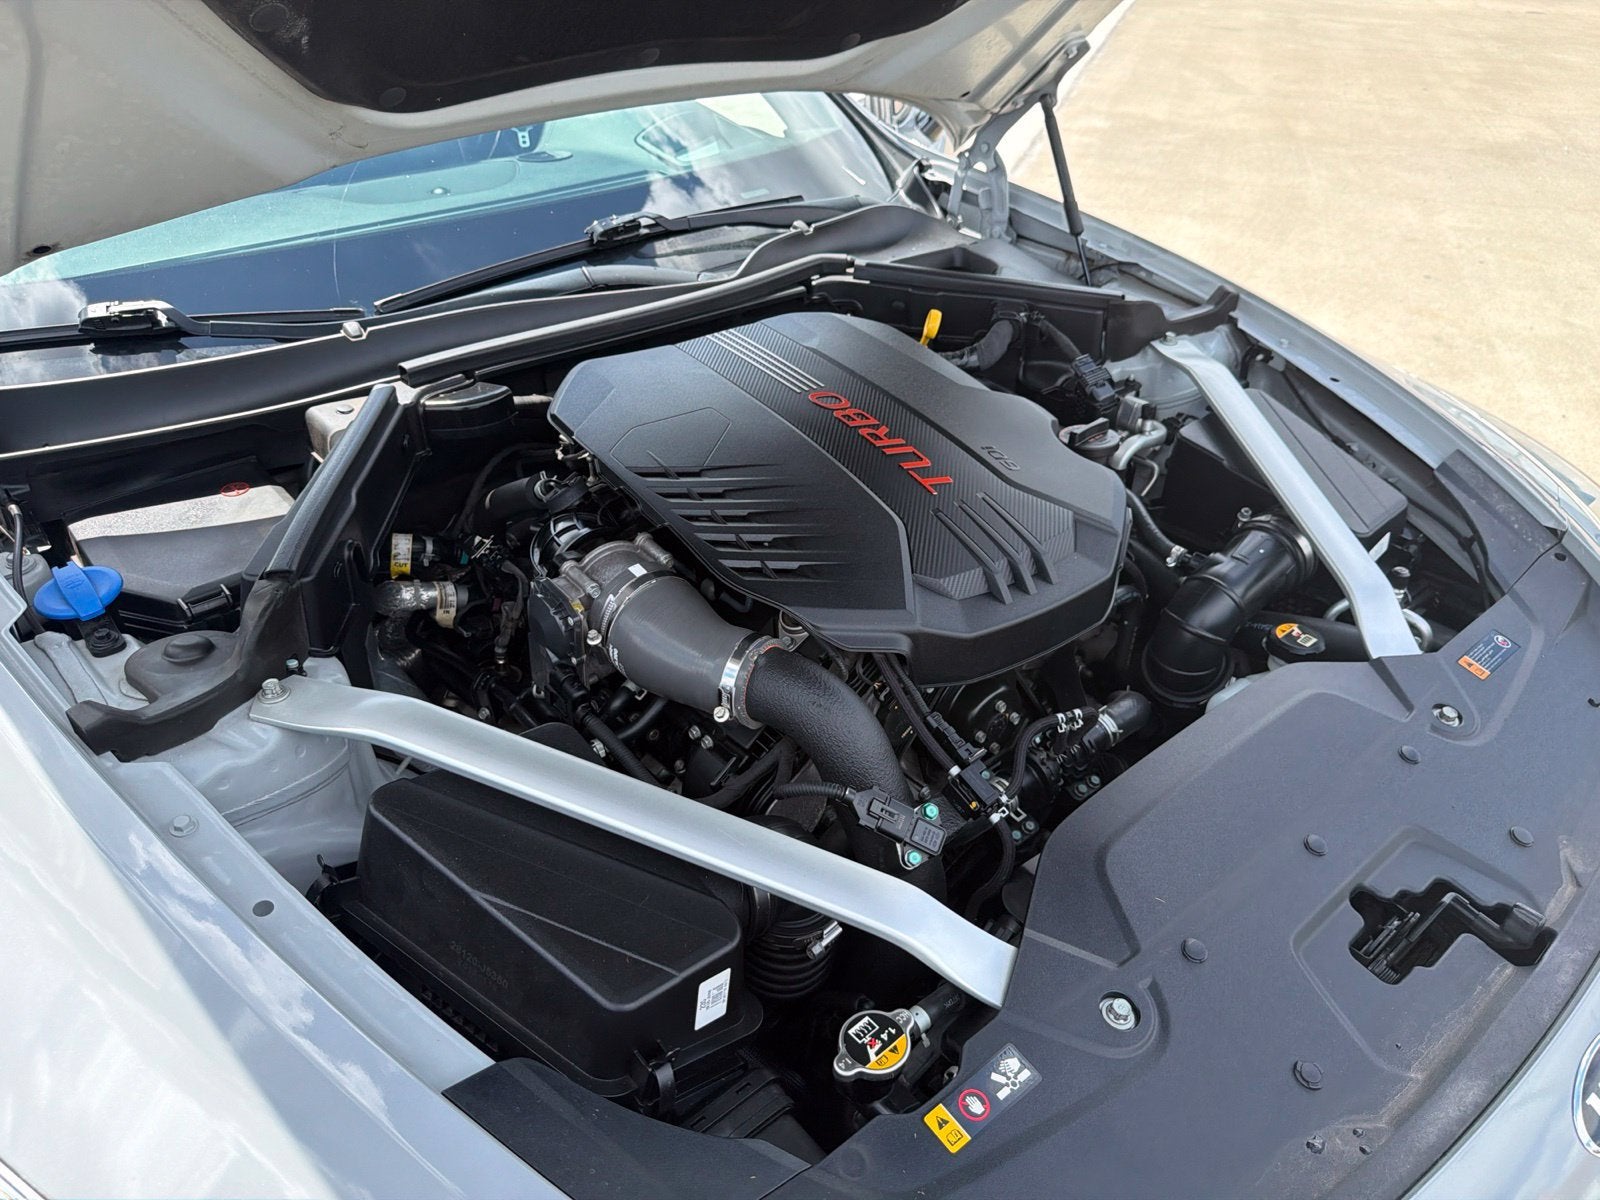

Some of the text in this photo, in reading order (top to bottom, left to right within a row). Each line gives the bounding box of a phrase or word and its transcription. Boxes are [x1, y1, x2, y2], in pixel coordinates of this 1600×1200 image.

[808, 391, 953, 496] TURBO
[880, 1027, 897, 1042] 1.4
[838, 1057, 852, 1070] 1.4
